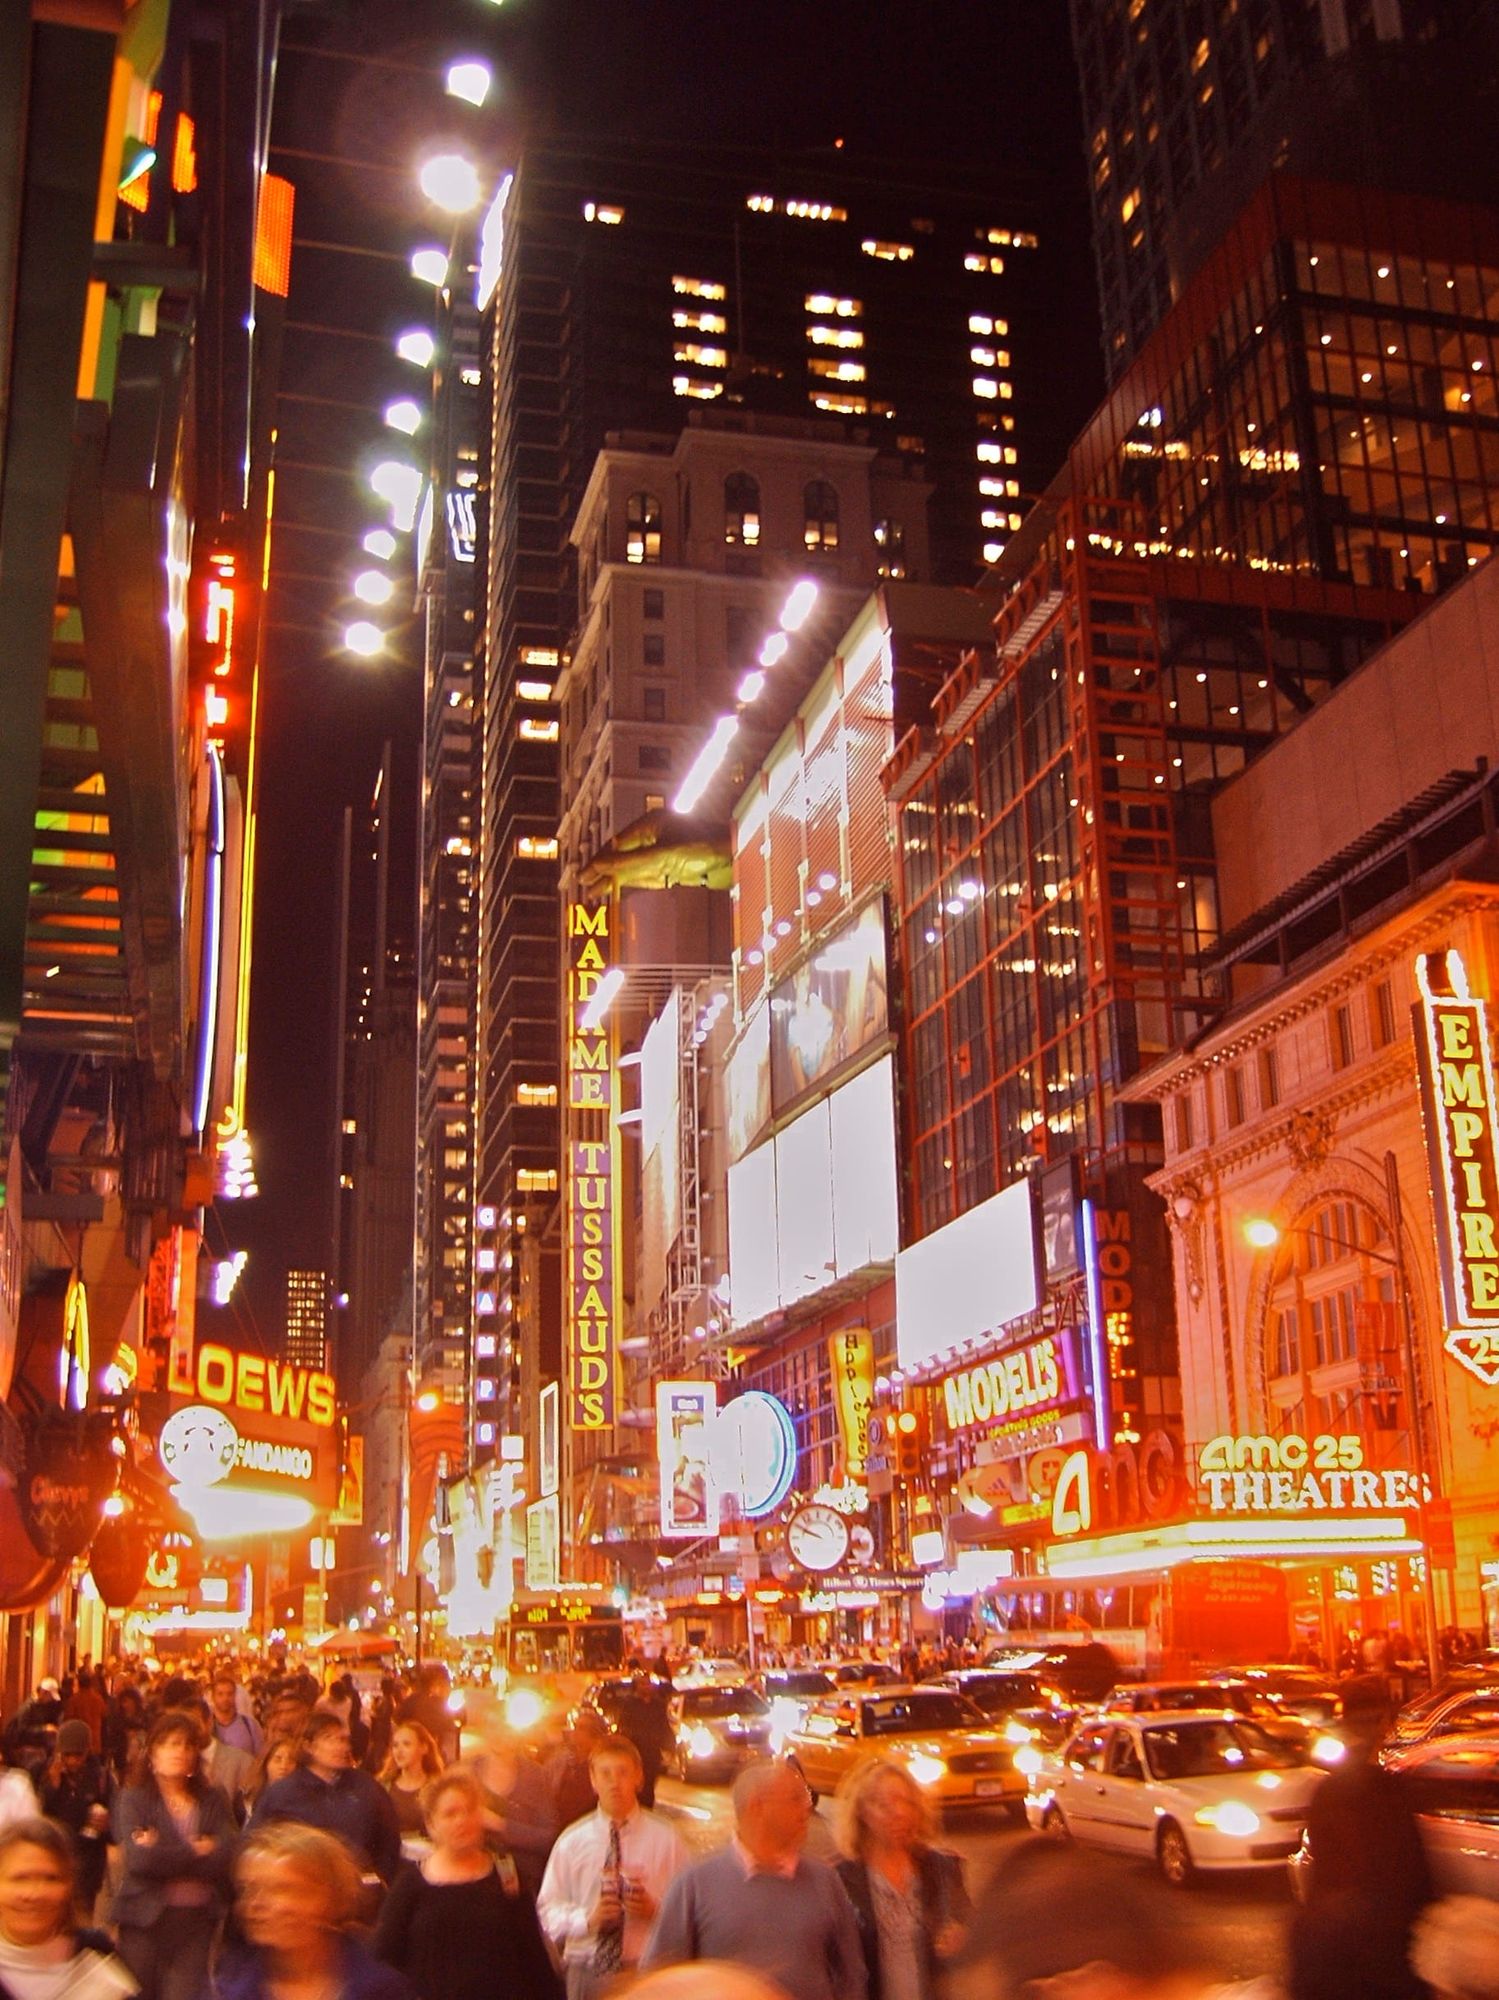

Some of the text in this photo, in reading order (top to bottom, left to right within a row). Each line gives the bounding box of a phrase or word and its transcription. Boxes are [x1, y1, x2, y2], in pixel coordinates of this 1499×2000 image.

[1438, 1013, 1499, 1310] EMPIRE
[476, 1206, 496, 1442] CAMP
[576, 1142, 608, 1427] TUSSAUD'S
[168, 1342, 336, 1429] LOEWS
[943, 1339, 1059, 1430] MODELL'S
[1469, 1336, 1499, 1365] 25
[236, 1438, 313, 1480] FANDANGO
[1201, 1470, 1433, 1510] THEATRES
[1314, 1434, 1364, 1469] 25
